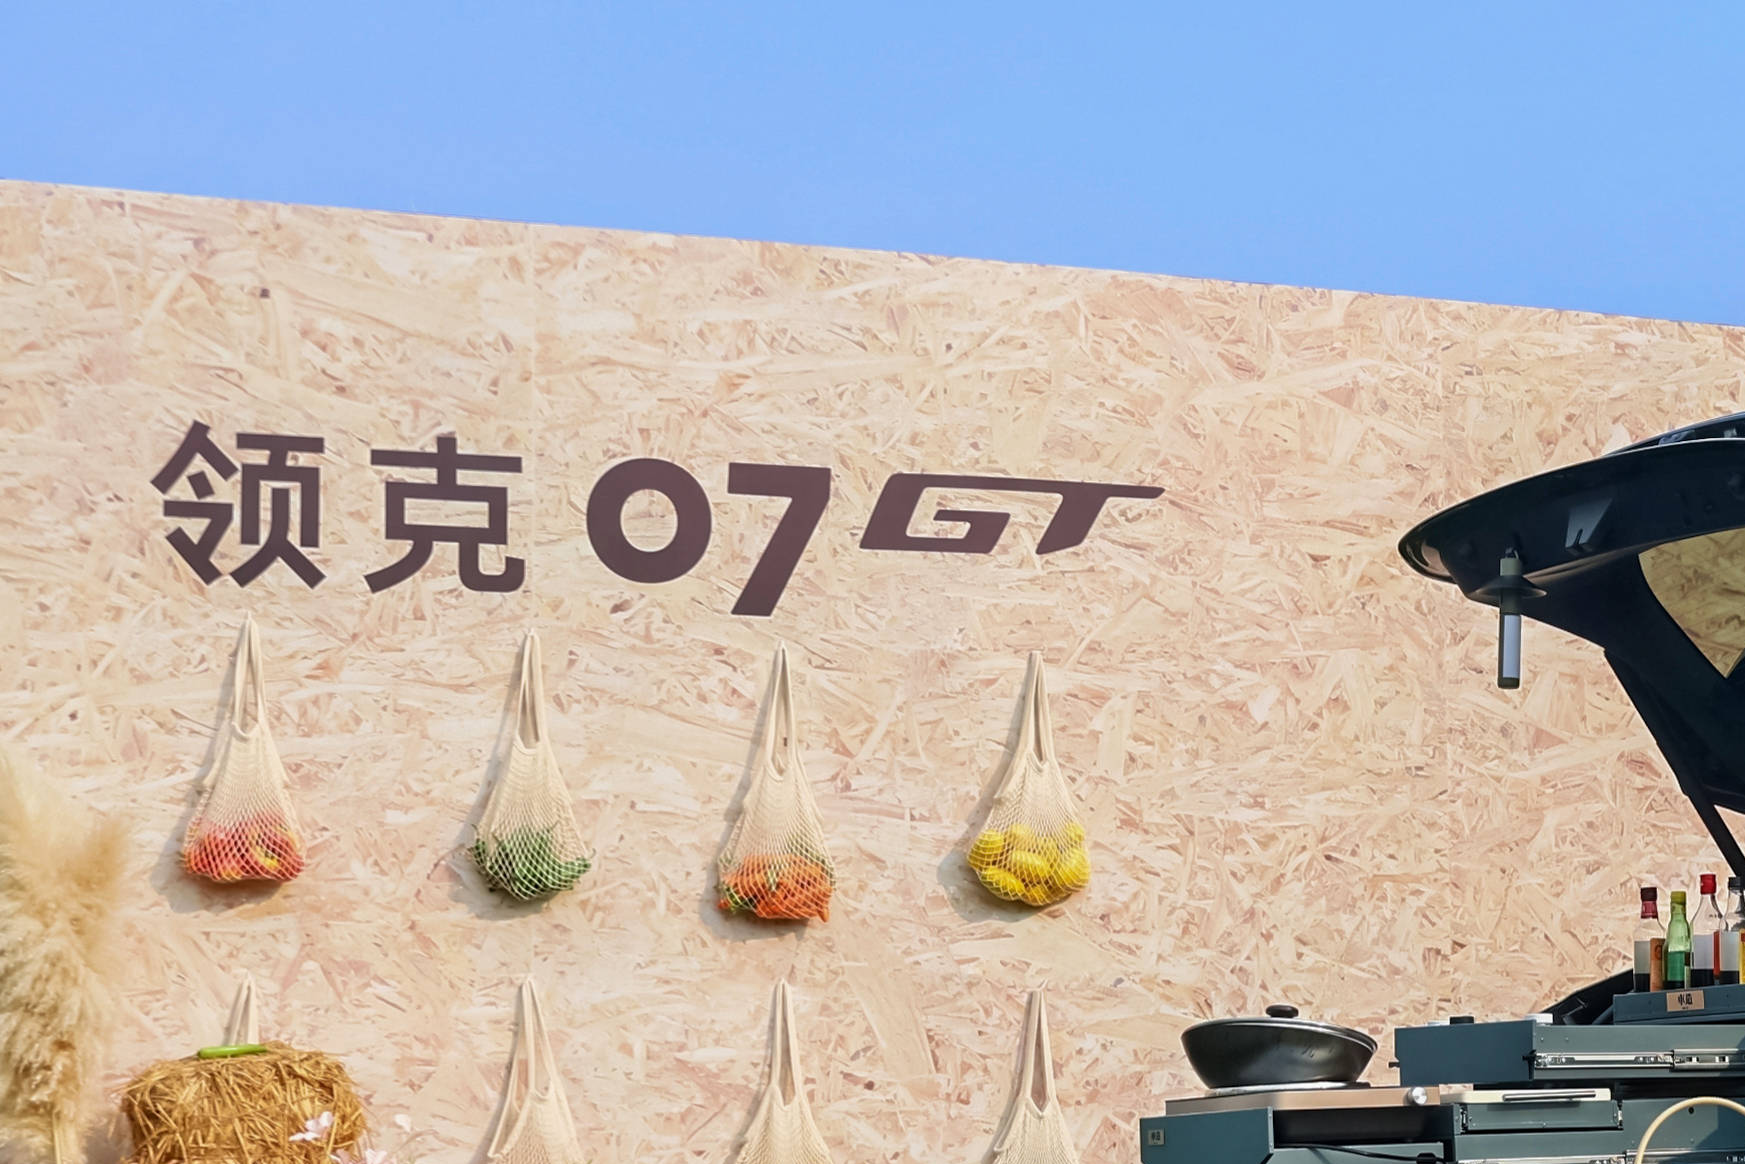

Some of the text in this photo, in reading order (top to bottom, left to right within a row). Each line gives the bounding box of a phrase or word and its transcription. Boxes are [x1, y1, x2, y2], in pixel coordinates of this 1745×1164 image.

[151, 421, 1167, 617] 领克 07 GT
